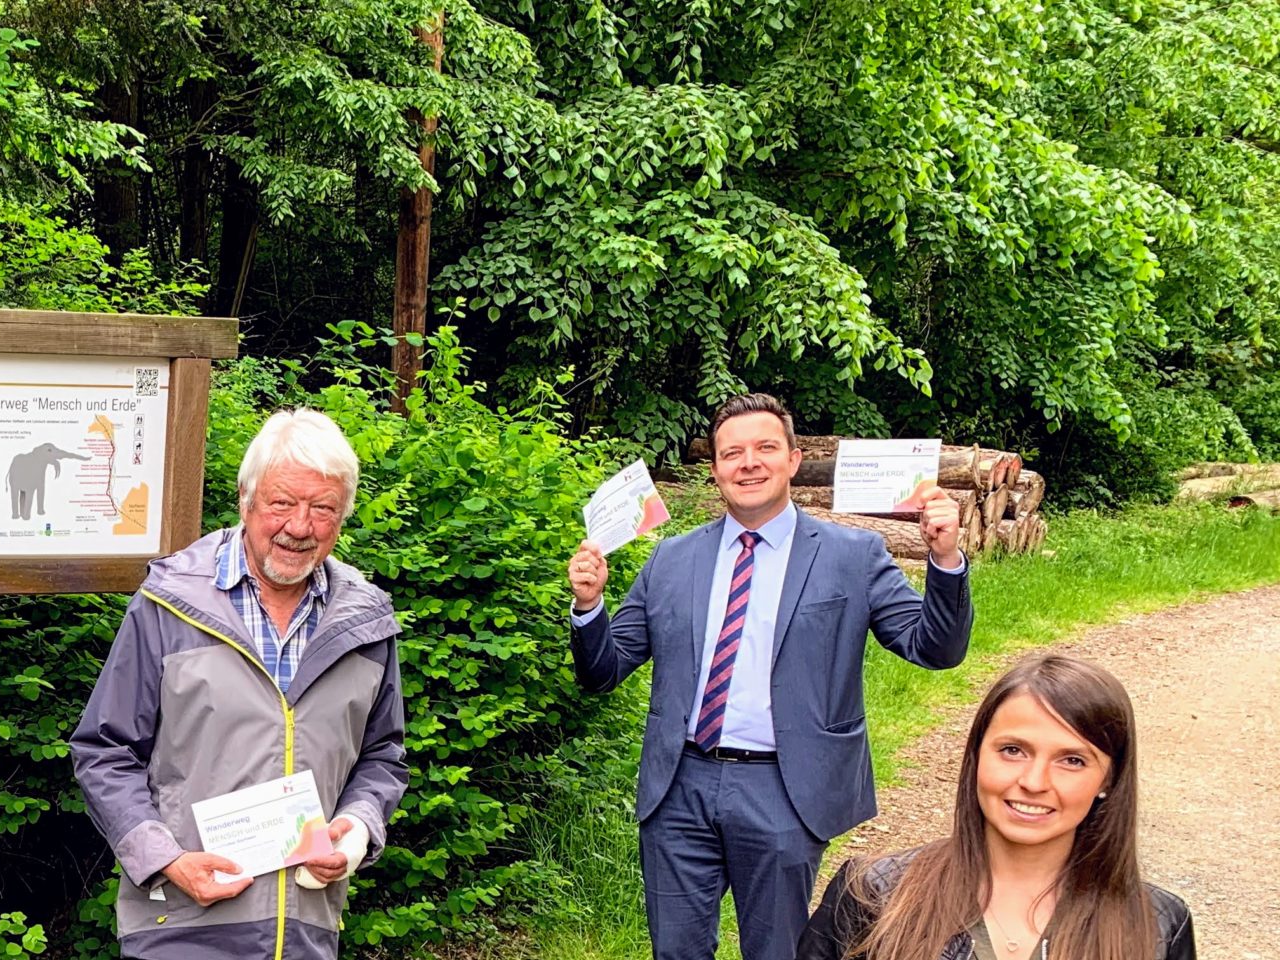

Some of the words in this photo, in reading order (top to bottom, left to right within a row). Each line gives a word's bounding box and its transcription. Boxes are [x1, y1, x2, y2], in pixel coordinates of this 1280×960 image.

[86, 397, 108, 411] und
[840, 461, 879, 469] Wanderweg
[205, 816, 250, 833] Wanderweg
[261, 816, 285, 830] ERDE
